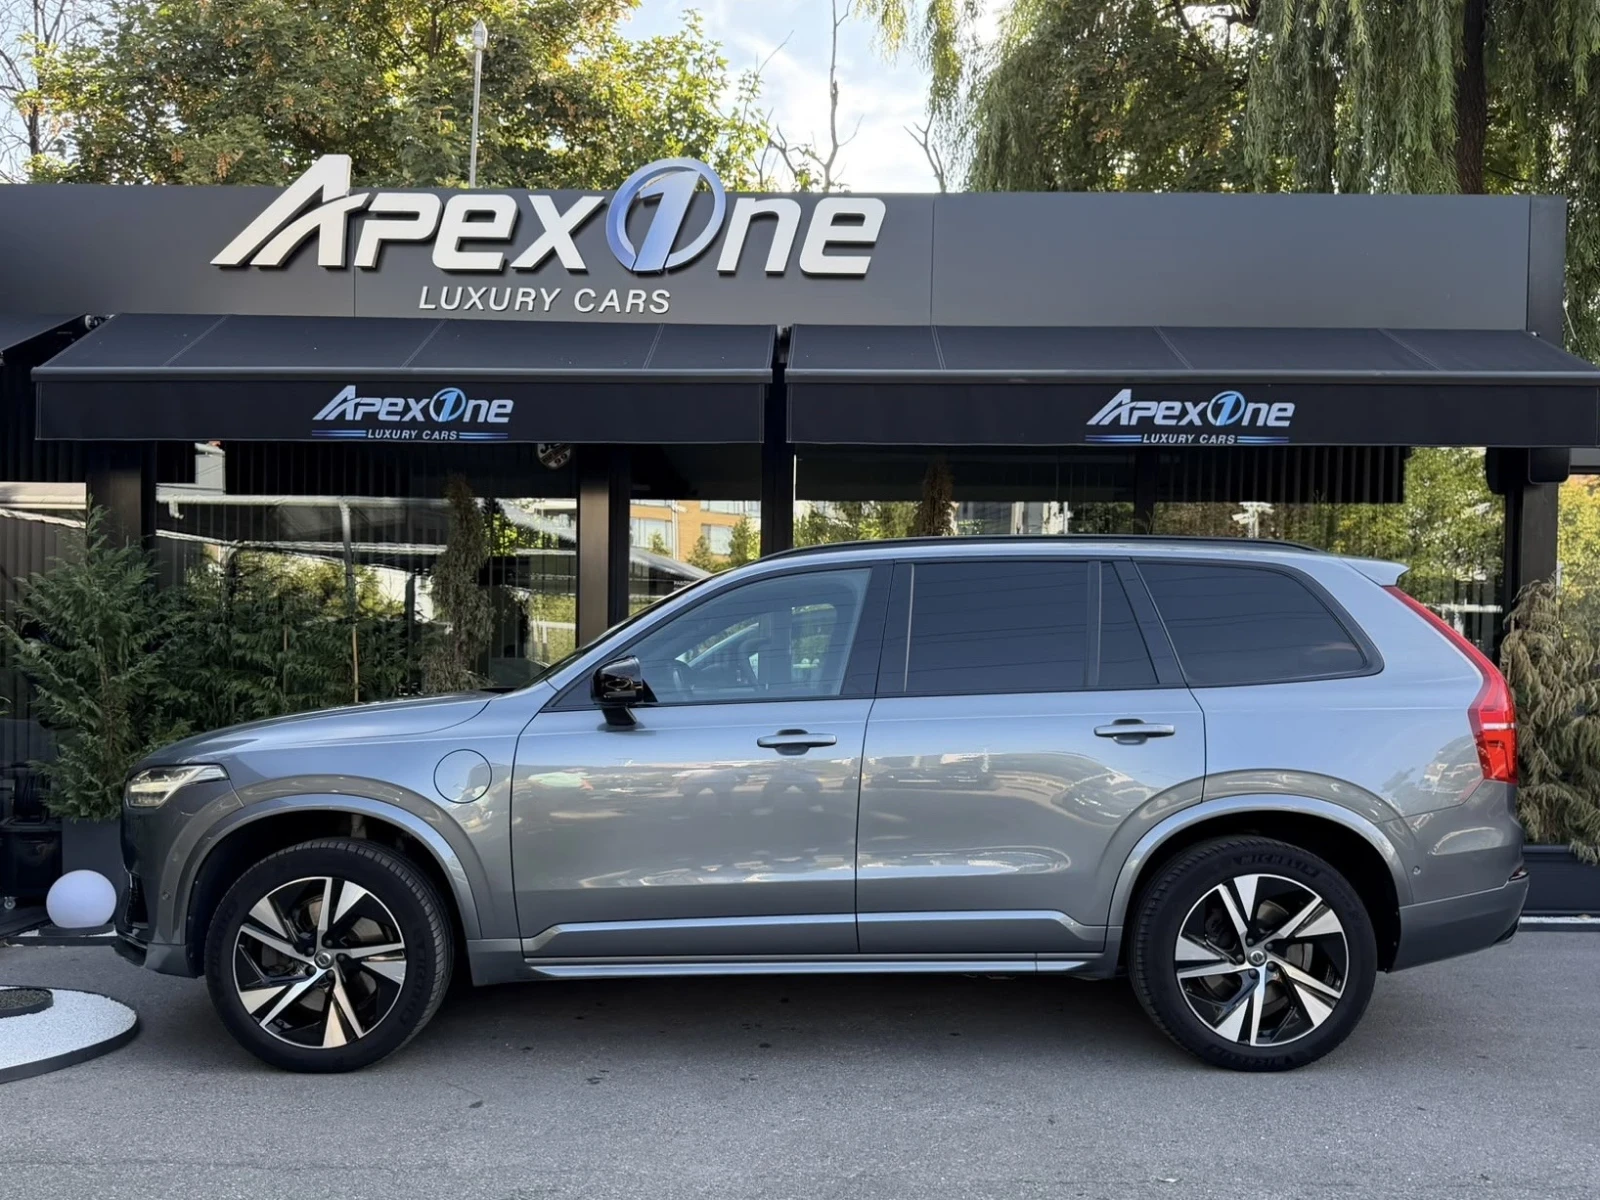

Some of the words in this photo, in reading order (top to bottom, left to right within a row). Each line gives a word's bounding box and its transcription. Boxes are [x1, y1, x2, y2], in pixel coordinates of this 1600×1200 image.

[419, 286, 562, 313] LUXURY
[573, 287, 671, 314] CARS
[367, 429, 418, 440] LUXURY
[422, 430, 458, 441] CARS
[1142, 433, 1195, 444] LUXURY
[1199, 434, 1236, 445] CARS
